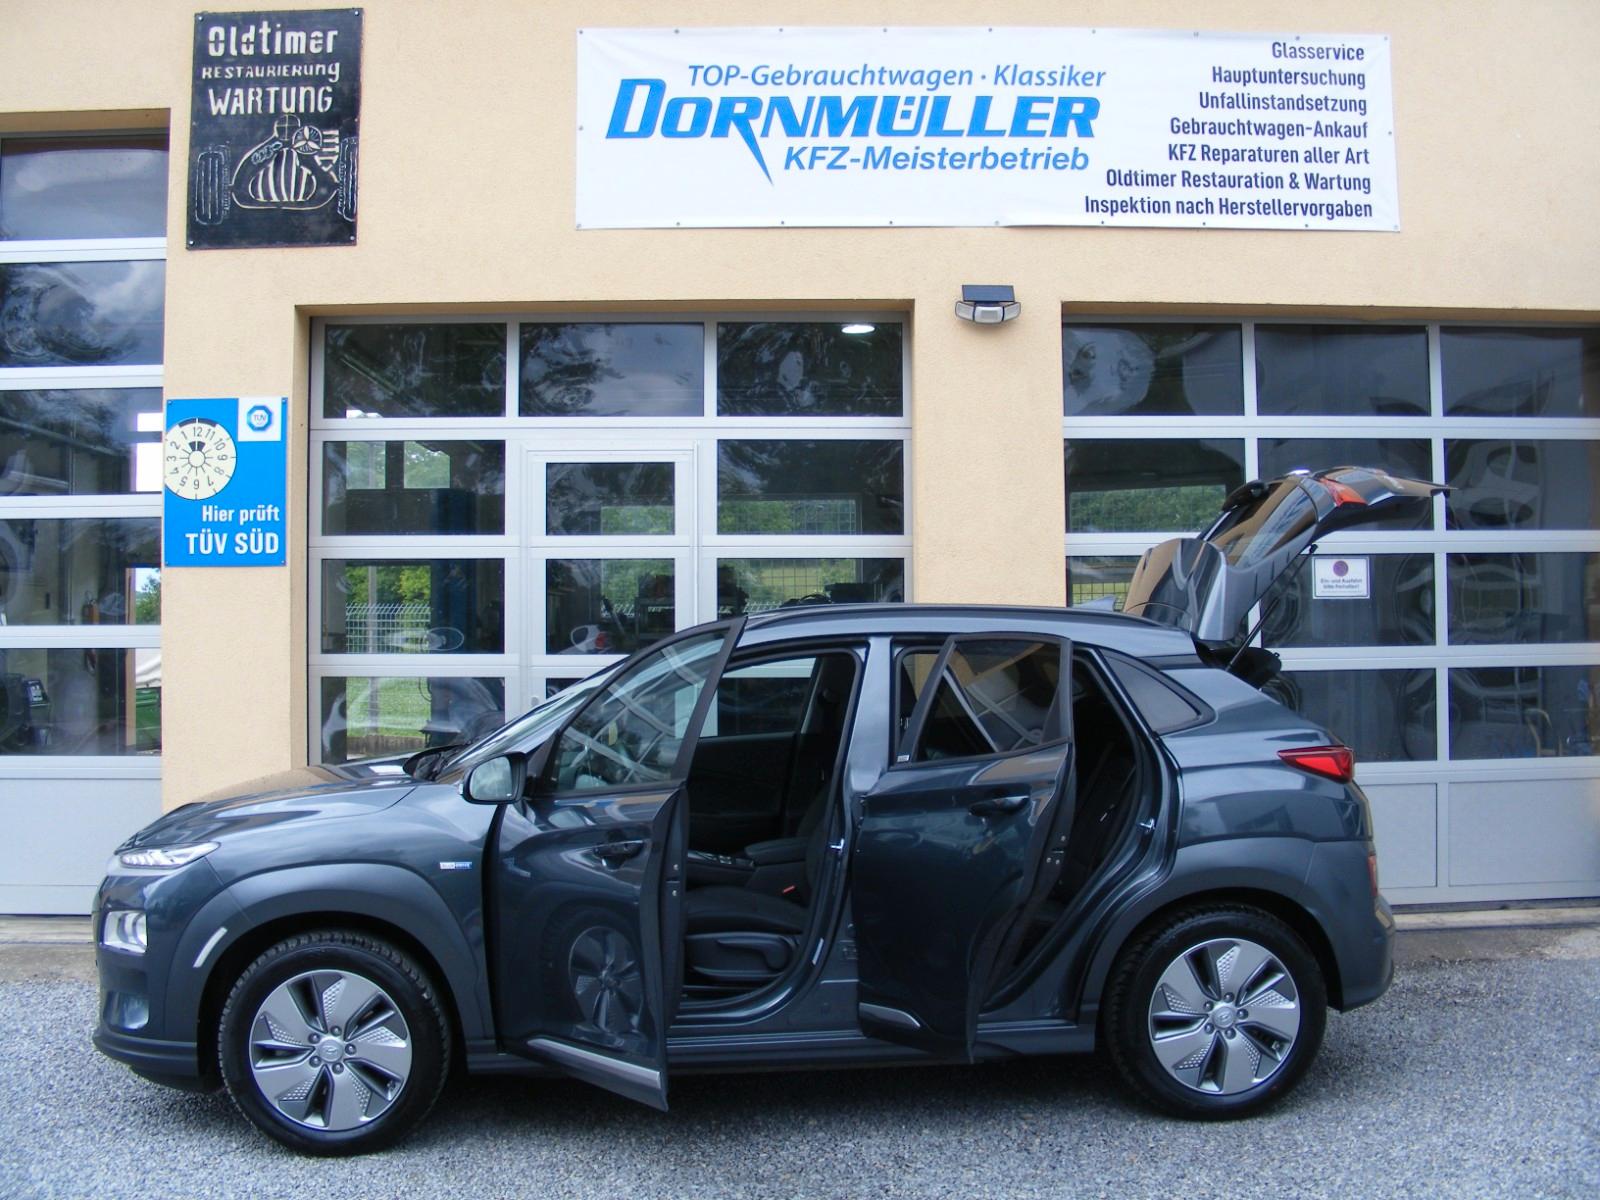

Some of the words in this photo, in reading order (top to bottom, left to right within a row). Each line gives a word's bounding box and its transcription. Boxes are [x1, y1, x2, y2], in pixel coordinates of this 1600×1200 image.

[208, 20, 338, 57] Oldtimer
[1272, 42, 1364, 61] Glasservice
[688, 64, 973, 91] TOP-Gebrauchtwagen
[994, 64, 1106, 87] Klassiker
[1212, 66, 1366, 89] Hauptuntersuchung
[208, 86, 333, 116] WARTUNG
[1199, 91, 1367, 116] Unfallinstandsetzung
[1170, 117, 1368, 140] Gebrauchtwagen-Ankauf
[784, 146, 1089, 171] KFZ-Meisterbetrieb
[1168, 144, 1196, 161] KFZ
[1201, 144, 1299, 165] Reparaturen
[1303, 147, 1339, 164] aller
[1345, 148, 1370, 165] Art
[1106, 169, 1177, 187] Oldtimer
[1182, 170, 1284, 189] Restauration
[1289, 172, 1300, 189] &
[1304, 172, 1371, 194] Wartung
[1085, 195, 1171, 217] Inspektion
[1176, 197, 1214, 215] nach
[1219, 198, 1373, 220] Herstellervorgaben
[193, 426, 203, 437] 12
[205, 428, 216, 441] 11
[170, 441, 181, 450] 2
[214, 438, 226, 451] 10
[179, 475, 188, 487] 5
[214, 466, 225, 476] 8
[193, 479, 200, 490] 6
[202, 505, 235, 522] Hier
[239, 505, 280, 525] prüft
[185, 528, 228, 555] TÜV
[235, 528, 279, 555] SÜD
